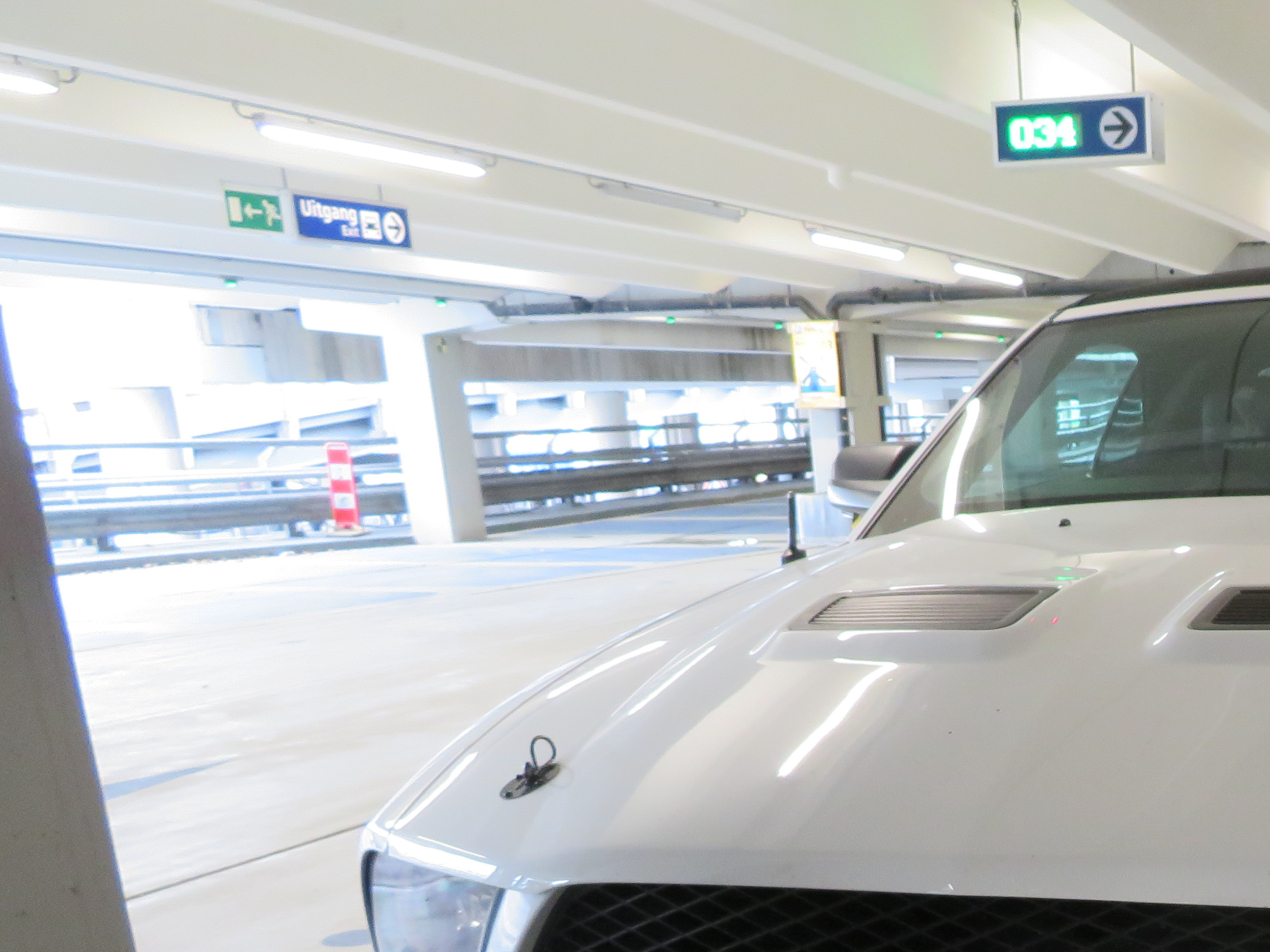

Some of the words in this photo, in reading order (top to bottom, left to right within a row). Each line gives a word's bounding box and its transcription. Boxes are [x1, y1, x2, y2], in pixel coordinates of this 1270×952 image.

[1008, 114, 1077, 150] 034
[300, 199, 357, 225] Uitgang
[341, 225, 360, 238] Exit
